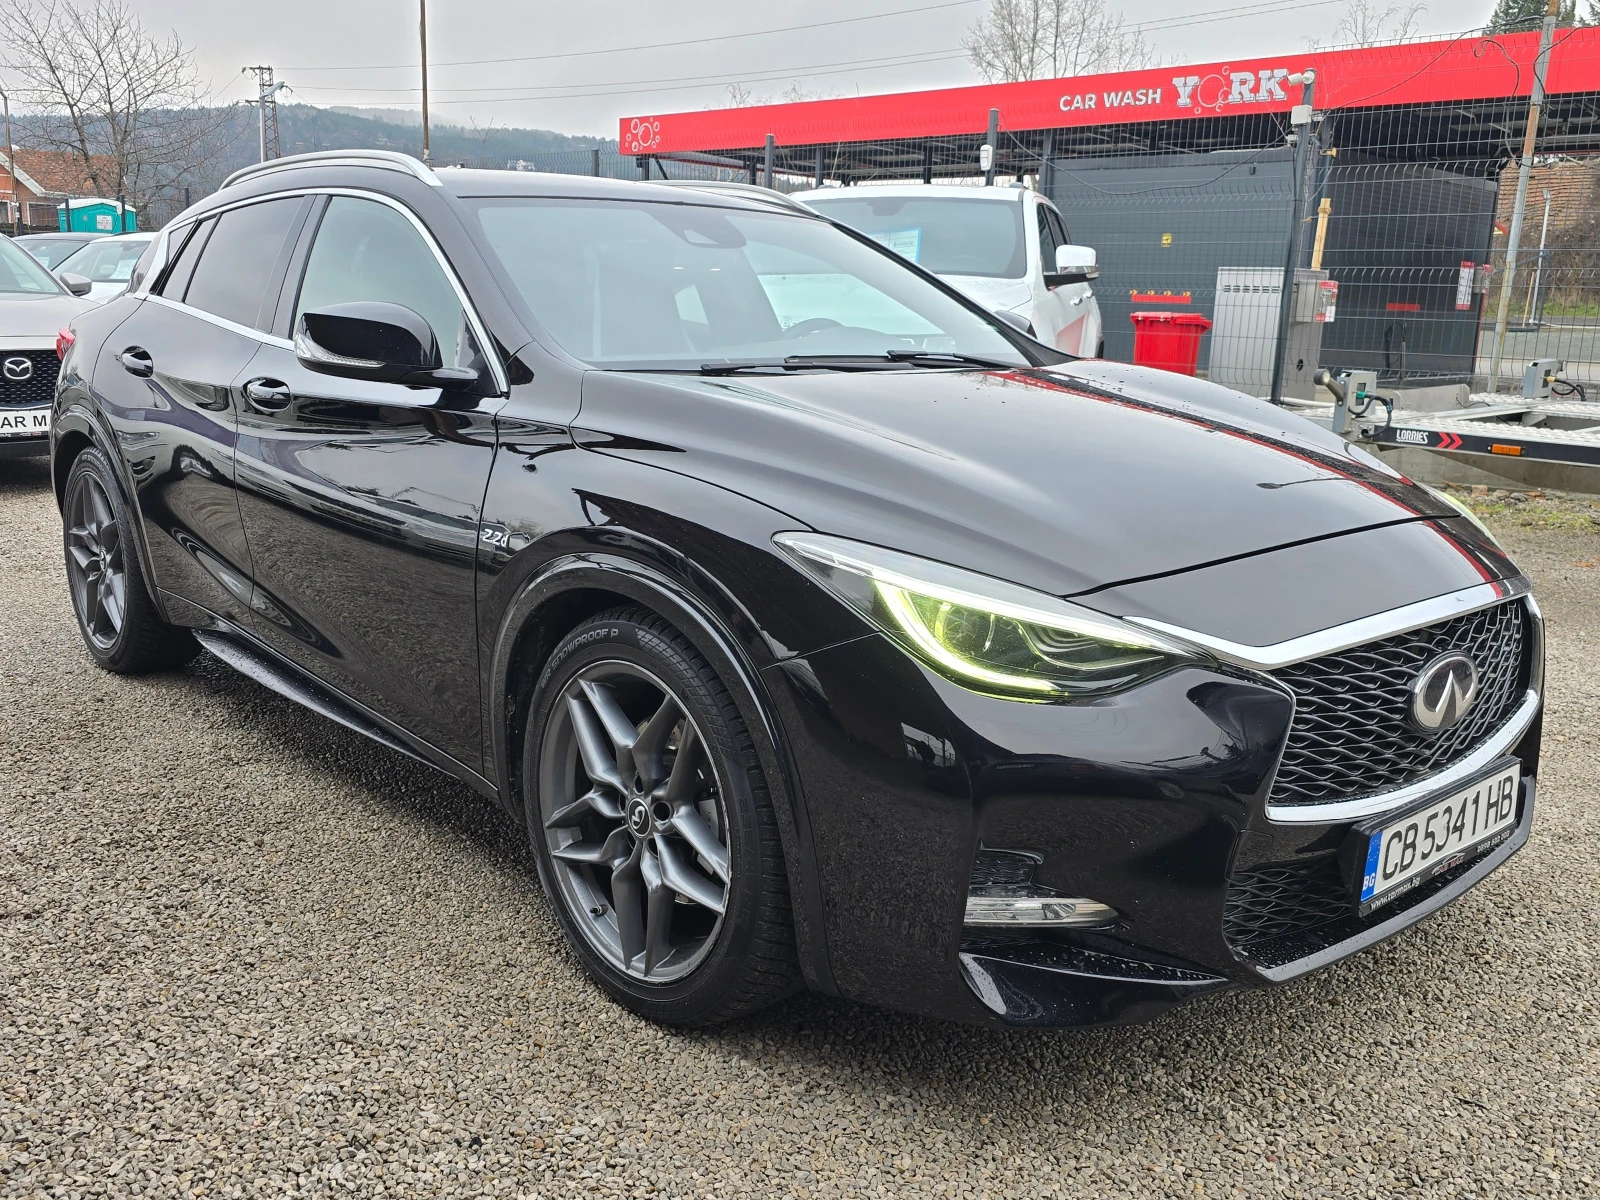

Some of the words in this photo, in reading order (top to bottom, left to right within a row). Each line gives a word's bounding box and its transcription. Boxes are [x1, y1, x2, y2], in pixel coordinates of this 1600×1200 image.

[1172, 68, 1289, 108] YORK
[1059, 93, 1096, 111] CAR
[1103, 88, 1162, 108] WASH
[32, 414, 50, 428] M
[1396, 429, 1429, 444] LORRIES
[551, 628, 608, 670] SNOWPROOF
[610, 628, 619, 638] P
[1362, 872, 1376, 891] BG
